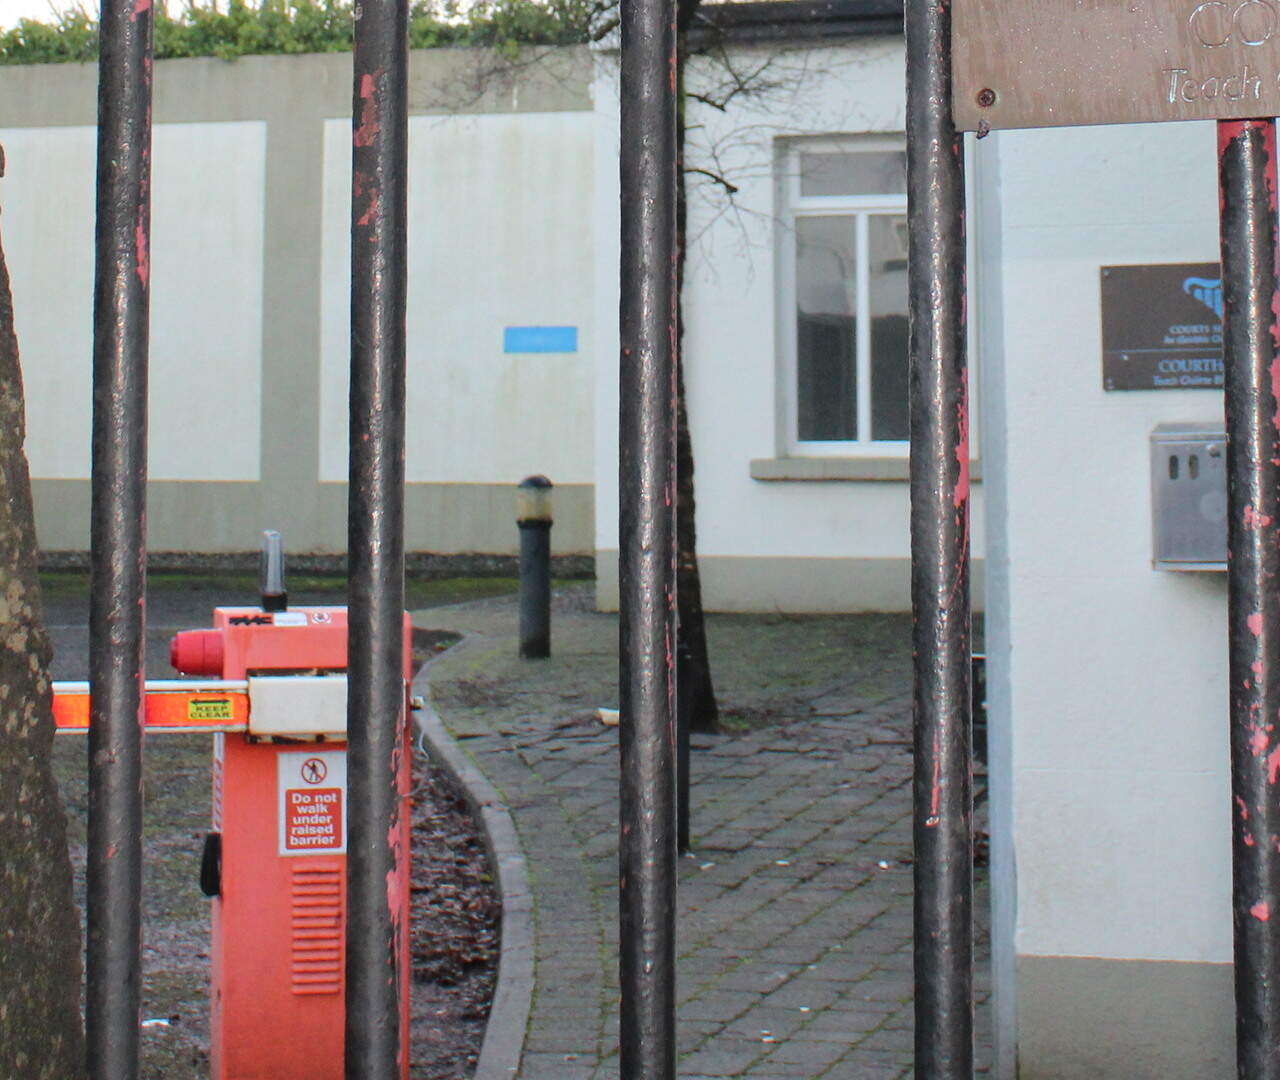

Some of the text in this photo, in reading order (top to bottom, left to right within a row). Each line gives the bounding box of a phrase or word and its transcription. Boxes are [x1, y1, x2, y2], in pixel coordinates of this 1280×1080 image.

[1164, 65, 1262, 104] Teach
[1158, 358, 1224, 373] COURTH
[291, 792, 337, 804] Do not
[296, 803, 329, 814] walk
[292, 814, 333, 824] under
[291, 824, 333, 835] raised
[290, 835, 336, 846] barrier
